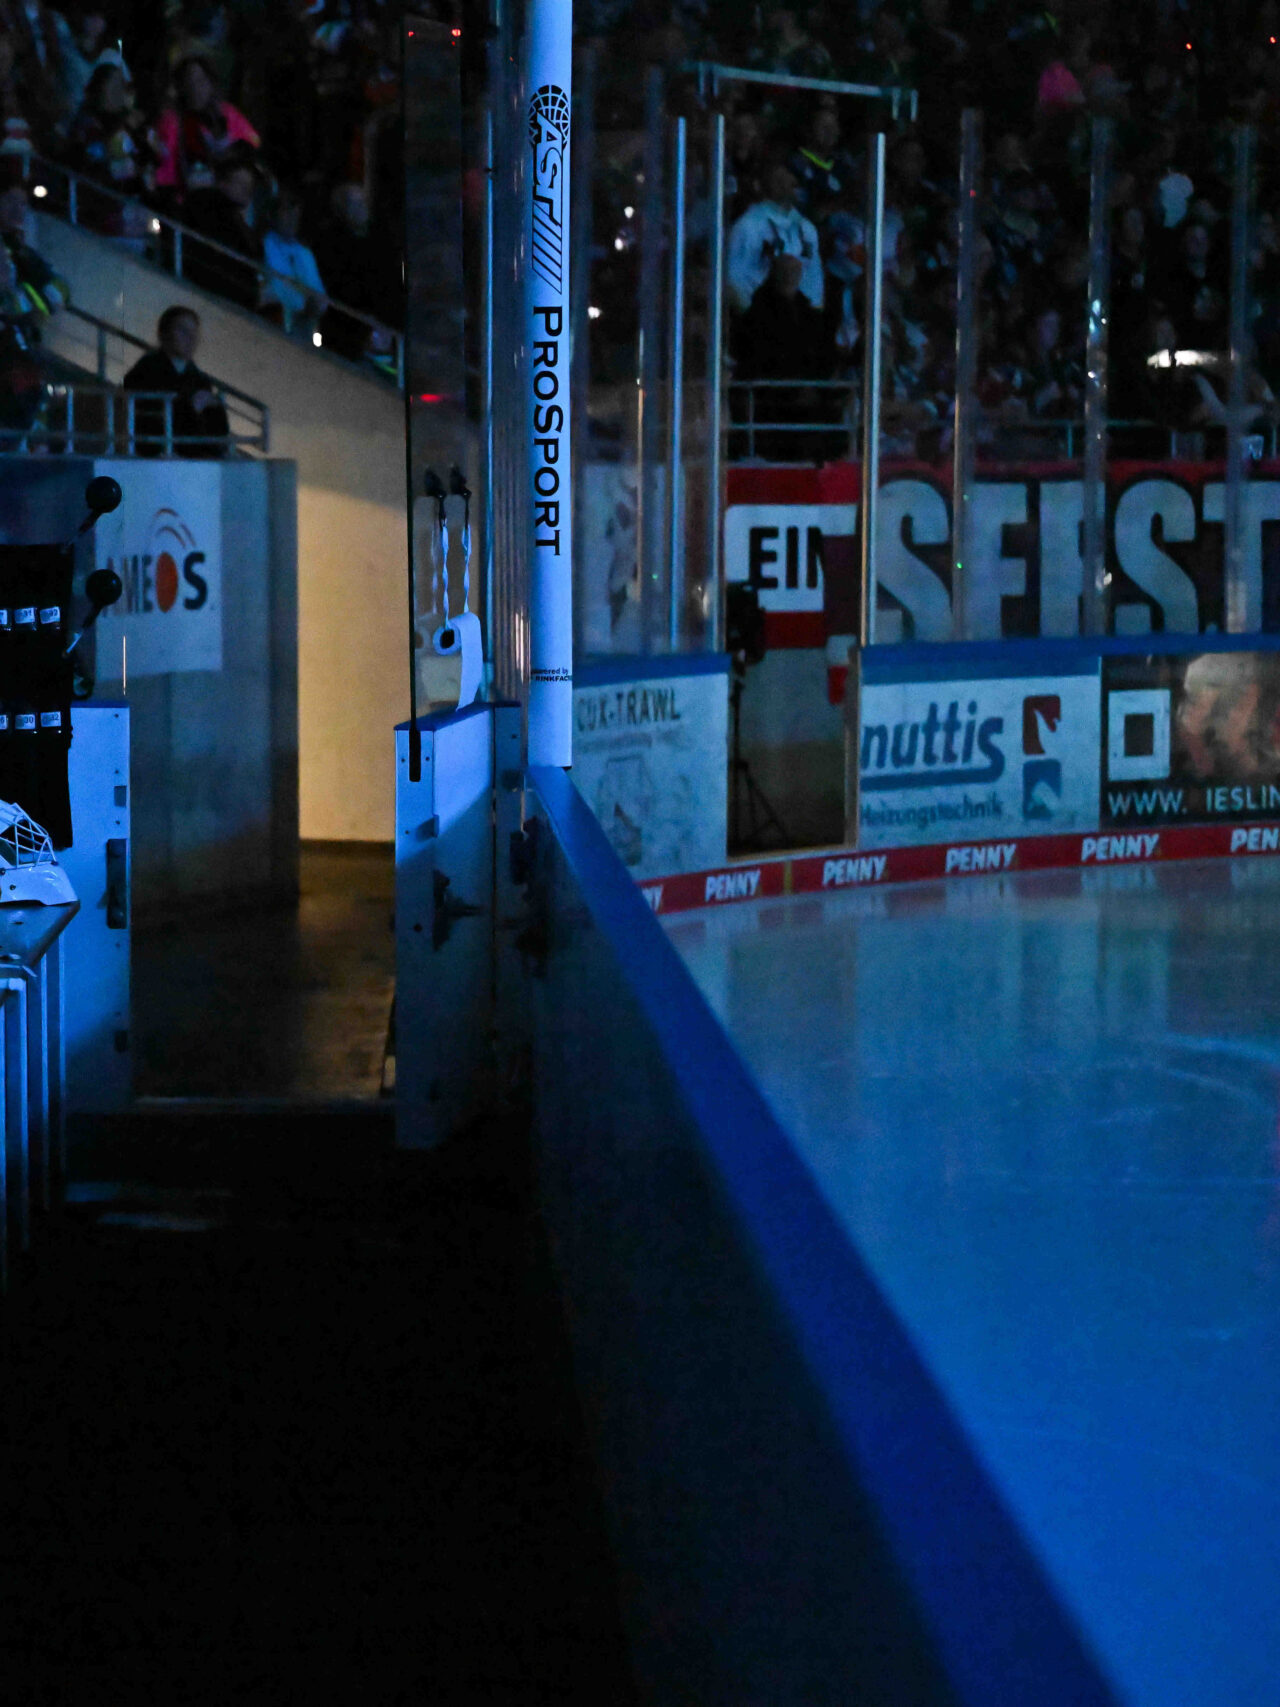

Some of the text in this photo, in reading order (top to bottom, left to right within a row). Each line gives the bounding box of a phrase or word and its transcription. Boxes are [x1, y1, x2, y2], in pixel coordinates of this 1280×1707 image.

[533, 305, 564, 556] PROSPORT
[704, 827, 1280, 902] PENNY PENNY PENNY PENNY PEN
